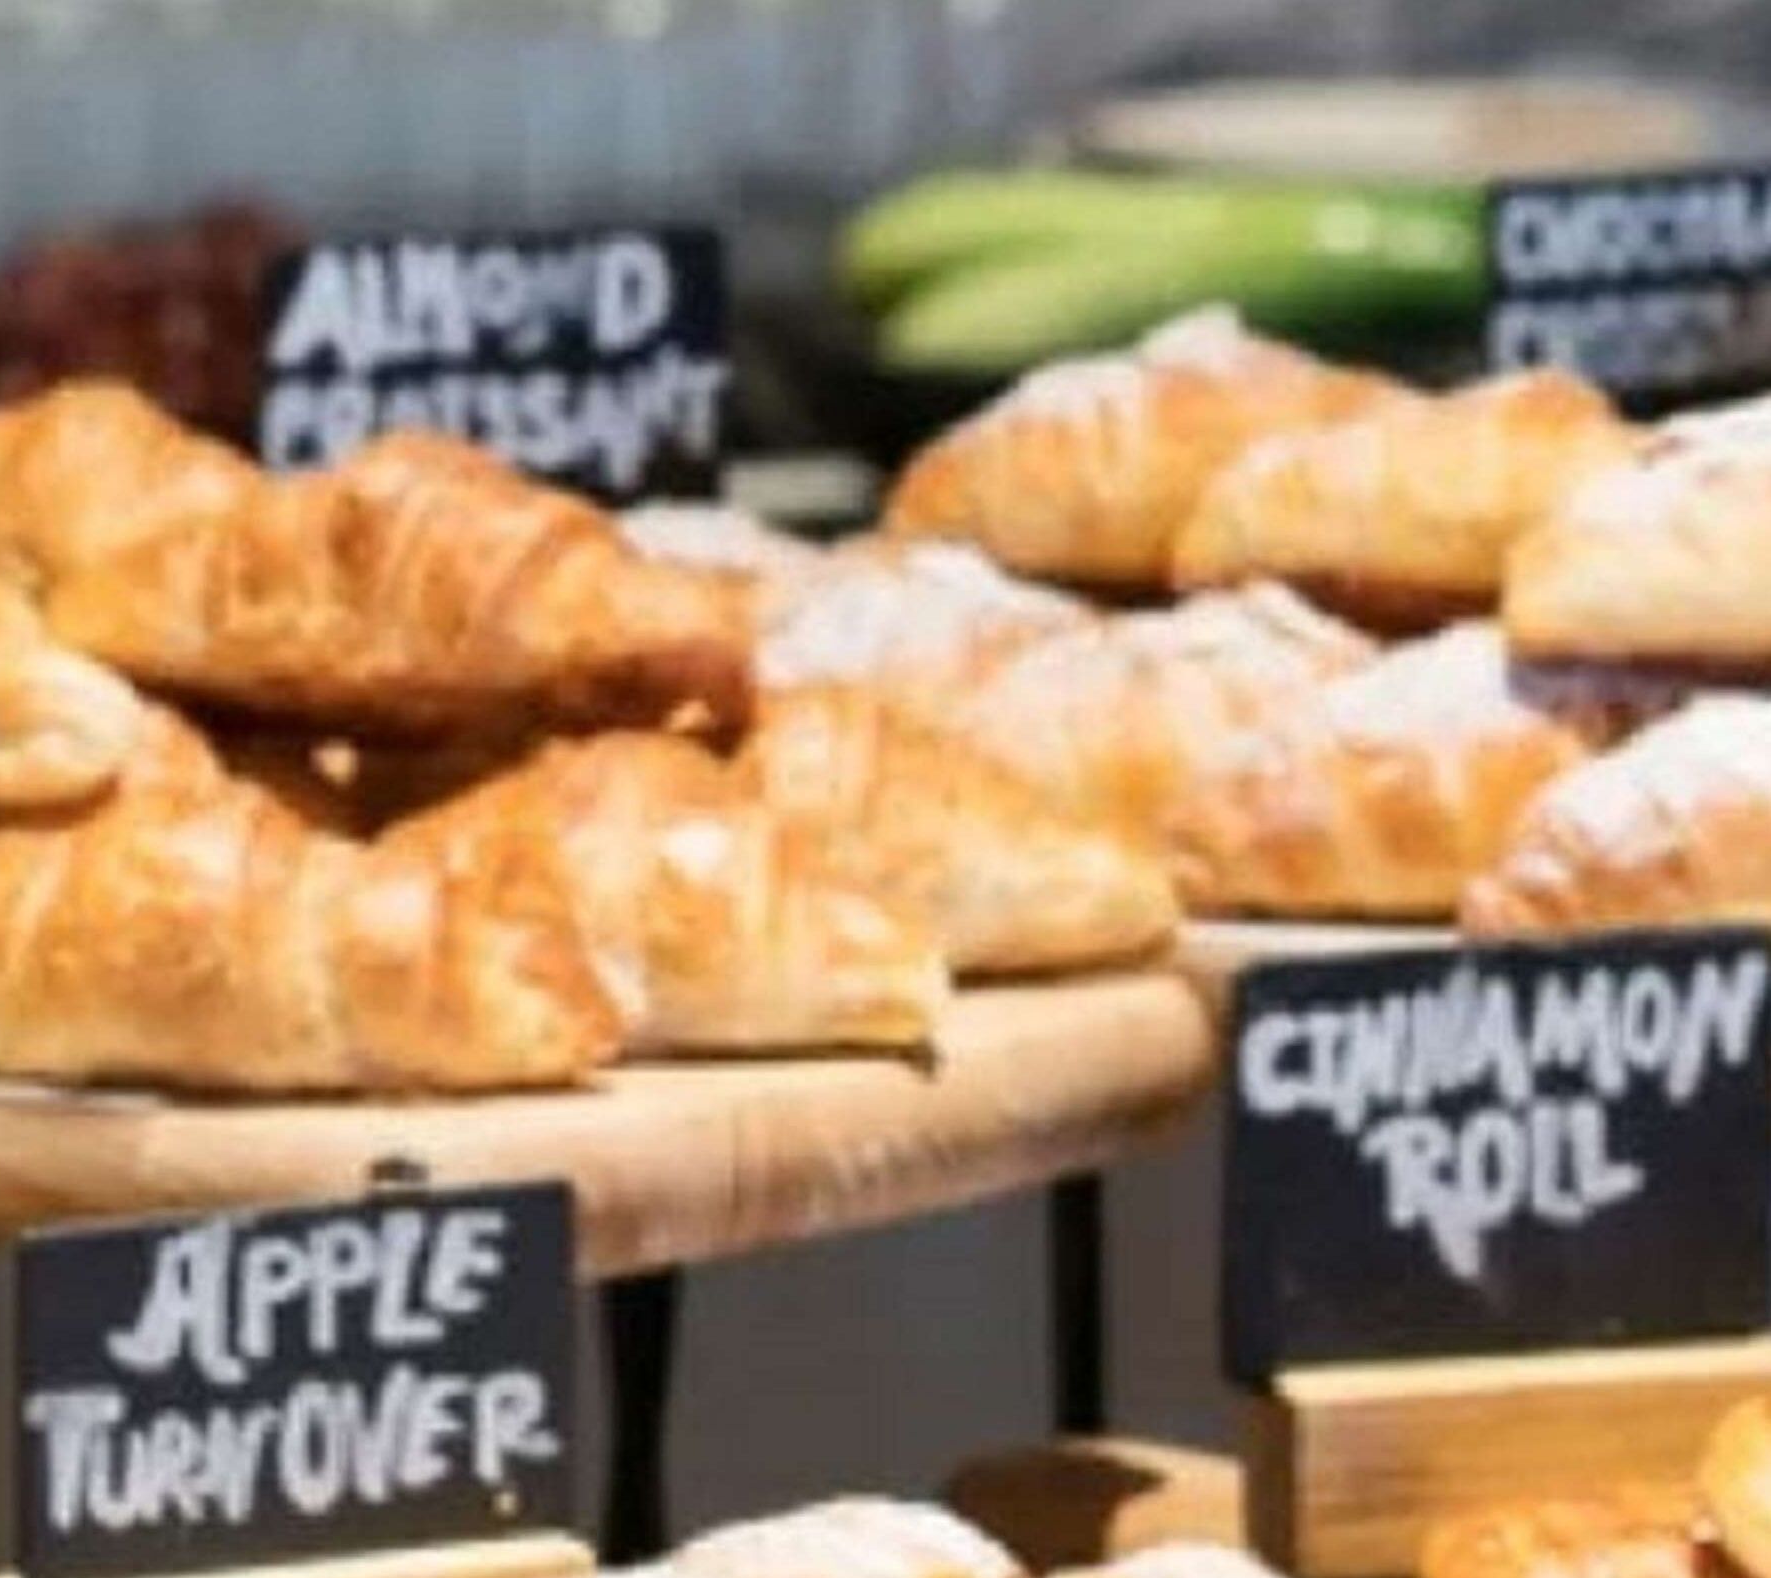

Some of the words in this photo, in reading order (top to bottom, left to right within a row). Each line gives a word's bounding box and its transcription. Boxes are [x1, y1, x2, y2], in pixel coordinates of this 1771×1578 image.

[1239, 954, 1768, 1134] CINNAMON
[1360, 1100, 1643, 1280] ROLL
[106, 1210, 507, 1384] APPLE
